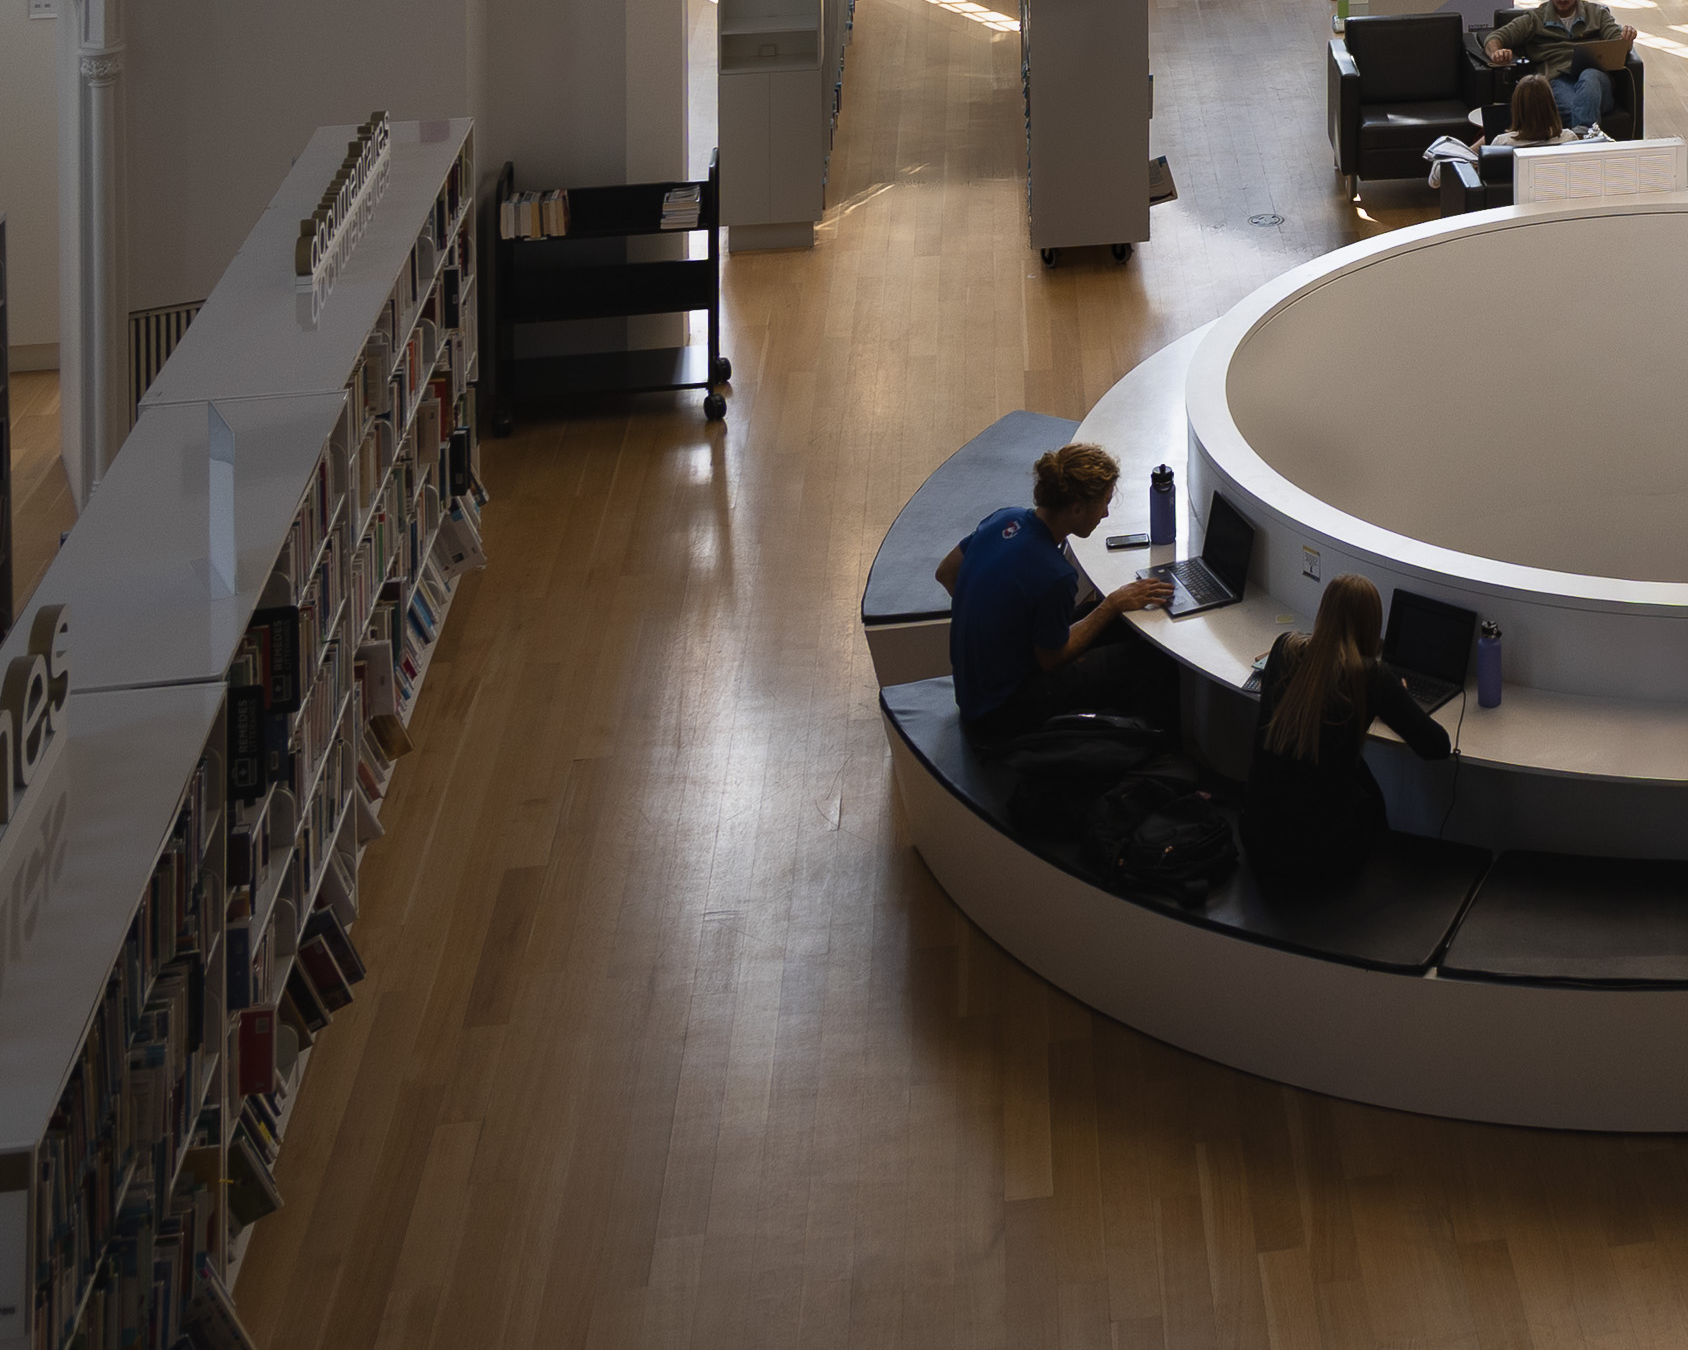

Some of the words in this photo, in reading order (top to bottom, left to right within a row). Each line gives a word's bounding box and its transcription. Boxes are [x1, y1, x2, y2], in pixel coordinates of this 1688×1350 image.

[308, 109, 391, 274] documentaires
[273, 619, 283, 671] REMÈDES
[238, 699, 248, 754] REMÈDES
